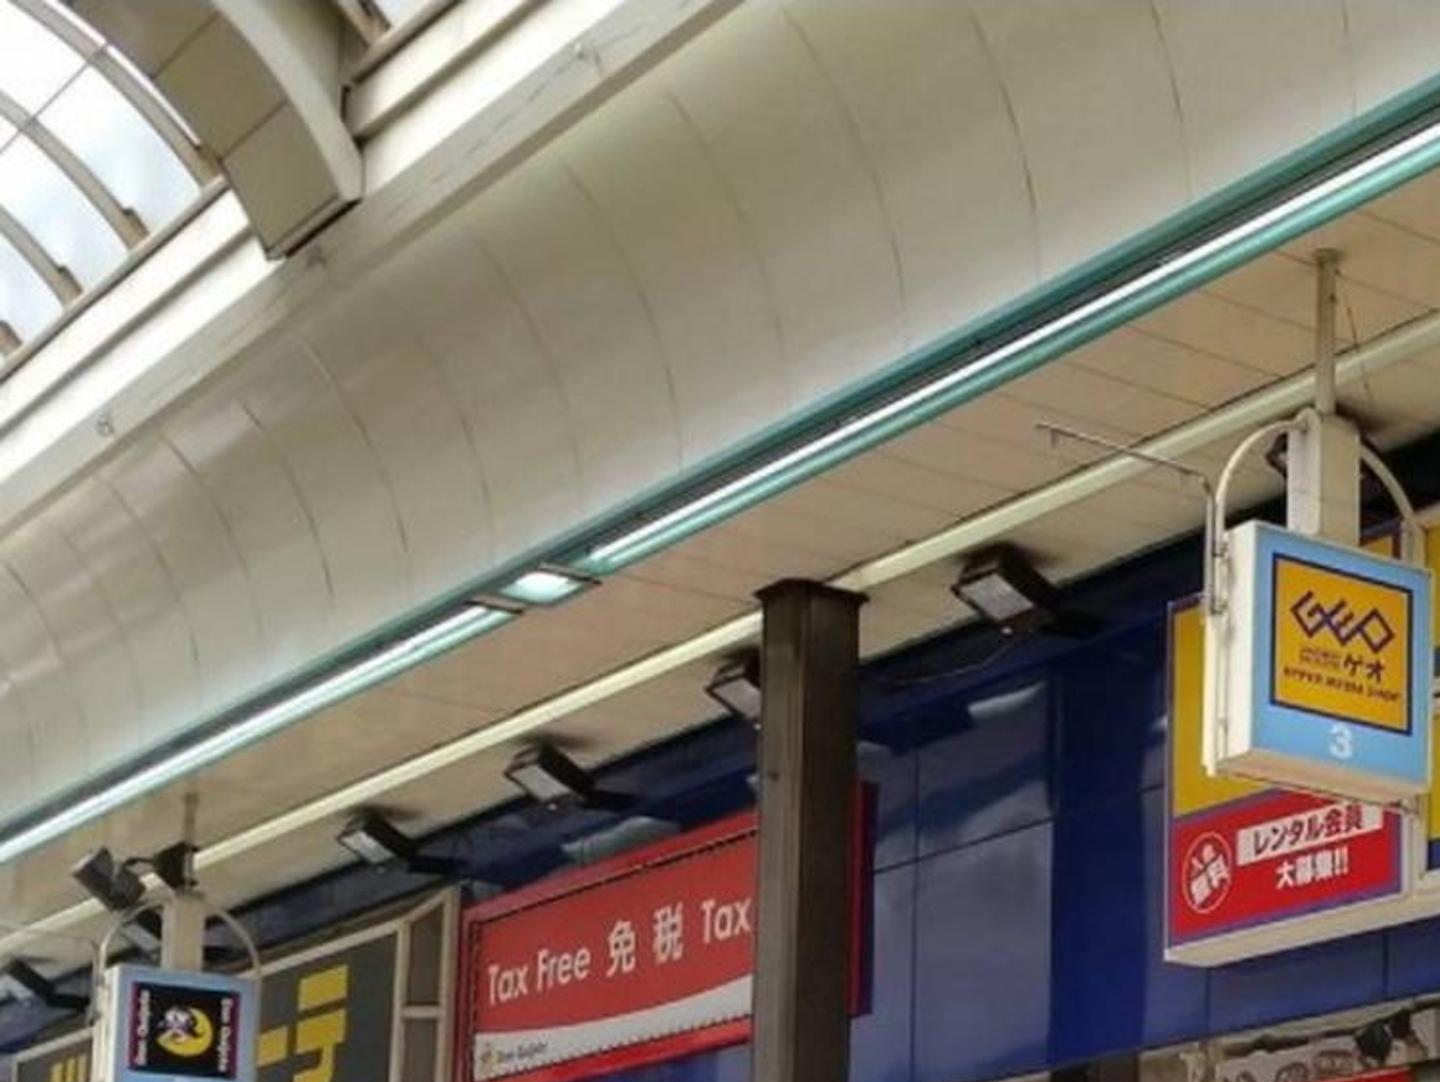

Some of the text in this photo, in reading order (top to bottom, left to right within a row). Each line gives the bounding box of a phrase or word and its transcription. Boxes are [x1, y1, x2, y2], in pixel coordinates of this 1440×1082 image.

[1329, 722, 1353, 760] 3
[1254, 801, 1363, 855] レンタル会員
[488, 962, 529, 1005] Tax
[536, 947, 592, 992] Free
[701, 898, 751, 943] Tax
